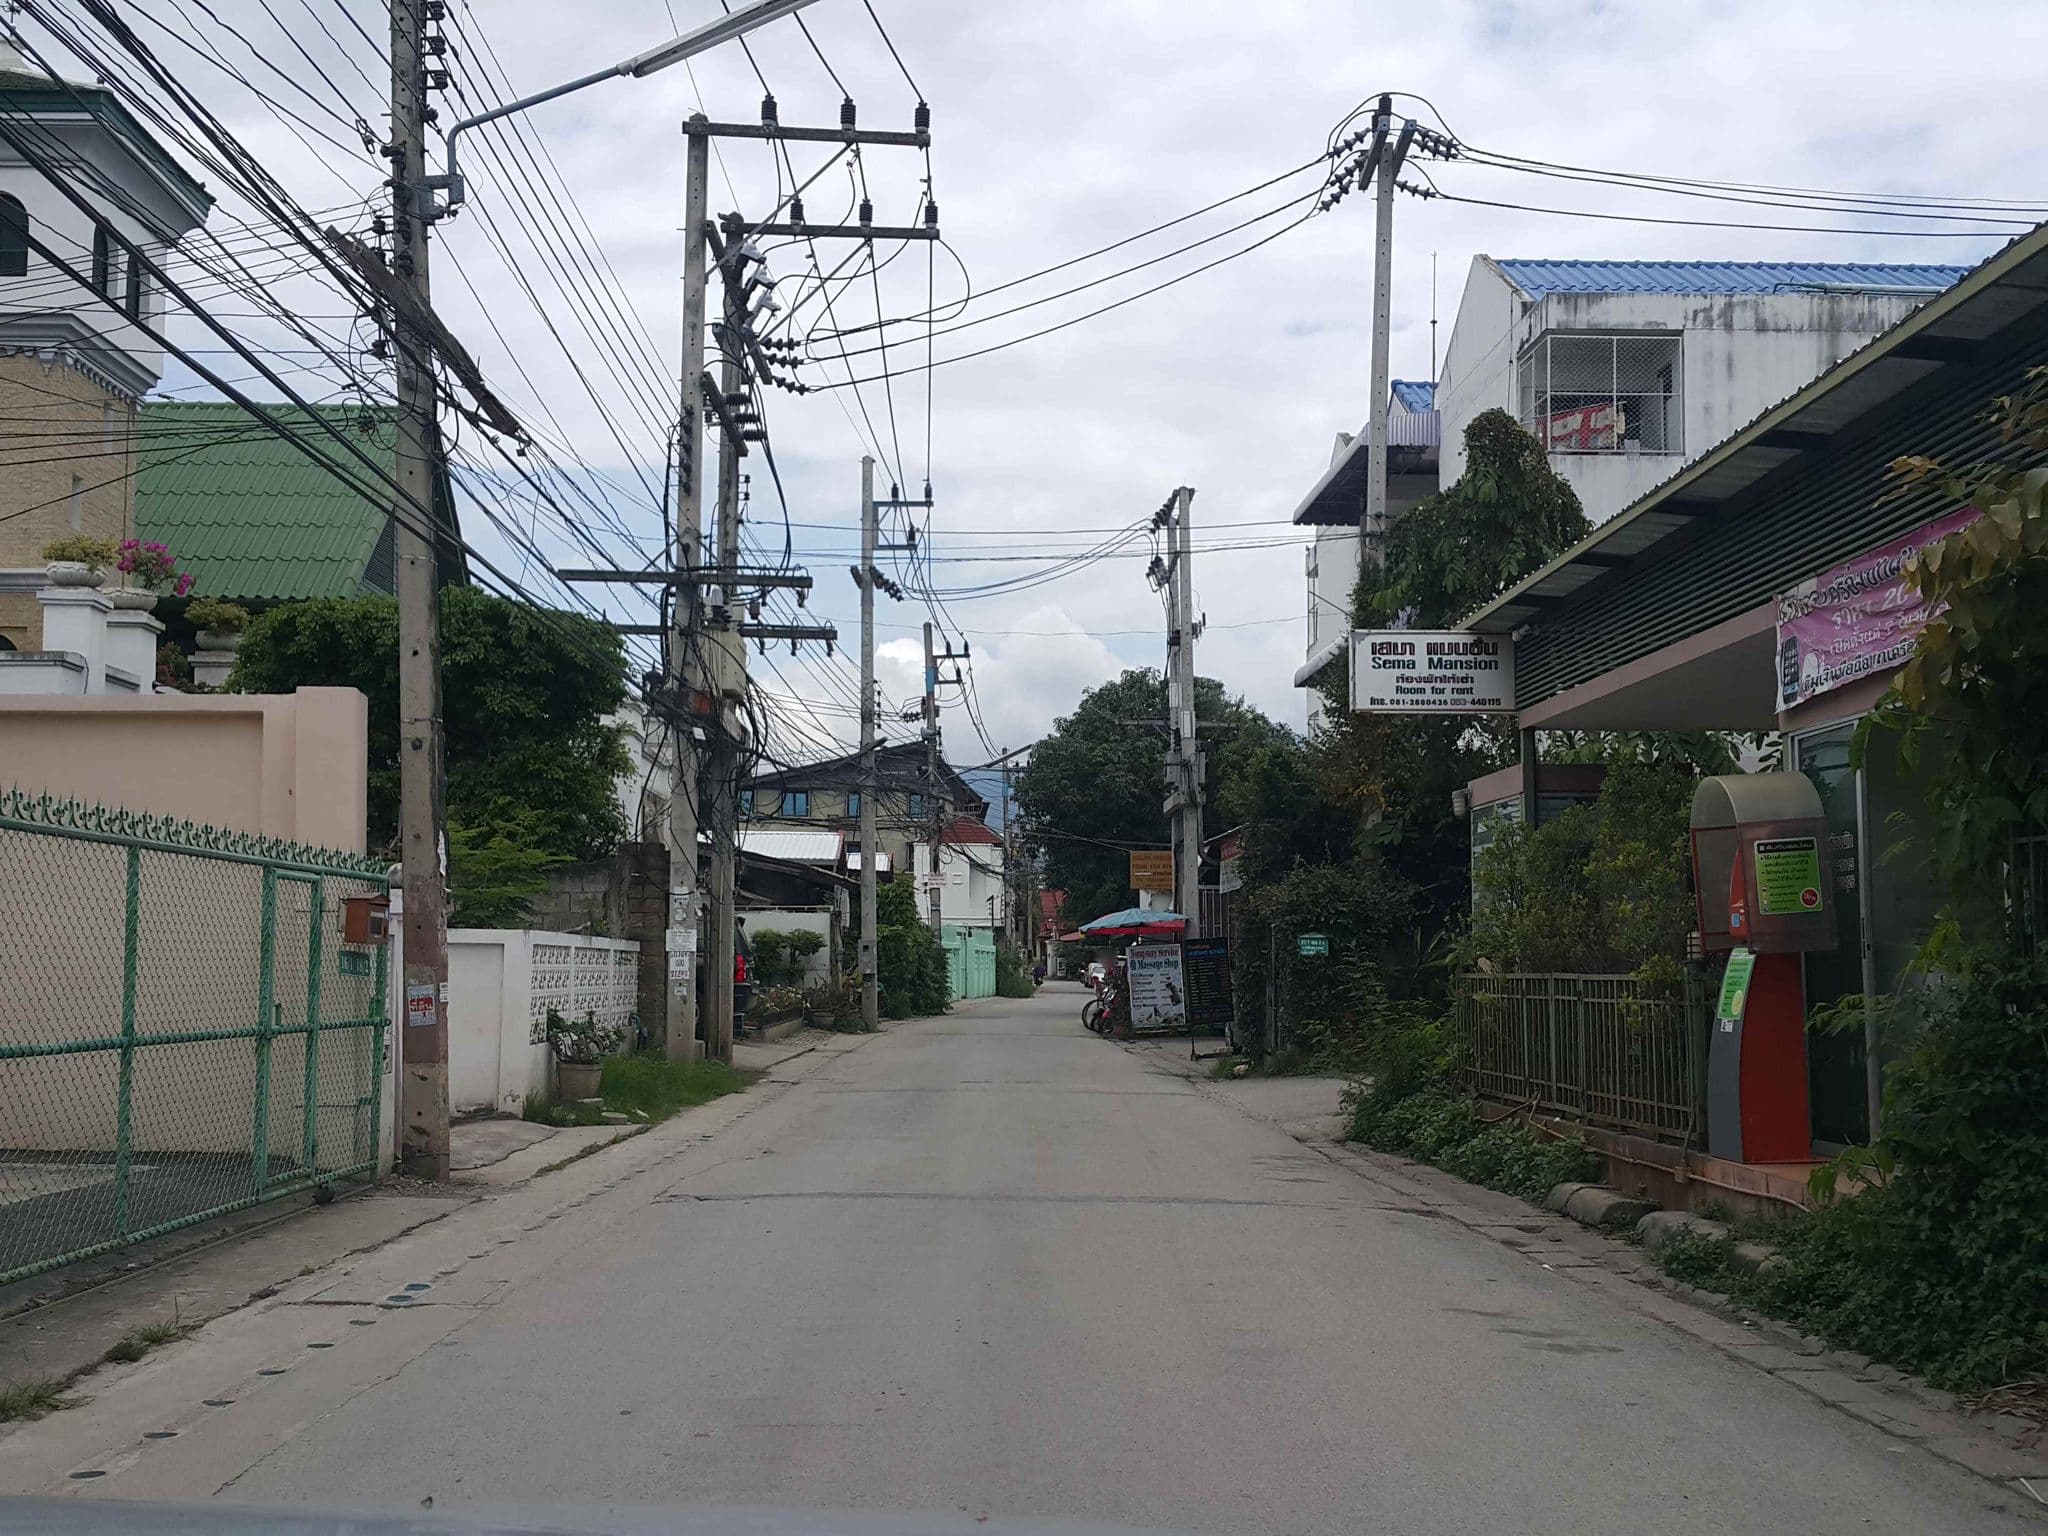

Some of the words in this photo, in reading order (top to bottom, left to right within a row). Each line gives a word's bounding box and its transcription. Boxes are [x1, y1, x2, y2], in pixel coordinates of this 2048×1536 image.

[1371, 641, 1415, 656] เสมา
[1426, 636, 1498, 656] แมนชั่น
[1372, 656, 1416, 670] Sema
[1428, 656, 1499, 670] Mansion
[1396, 685, 1426, 695] Room
[1431, 685, 1446, 695] for
[1451, 686, 1474, 695] rent
[1137, 959, 1163, 971] Massage
